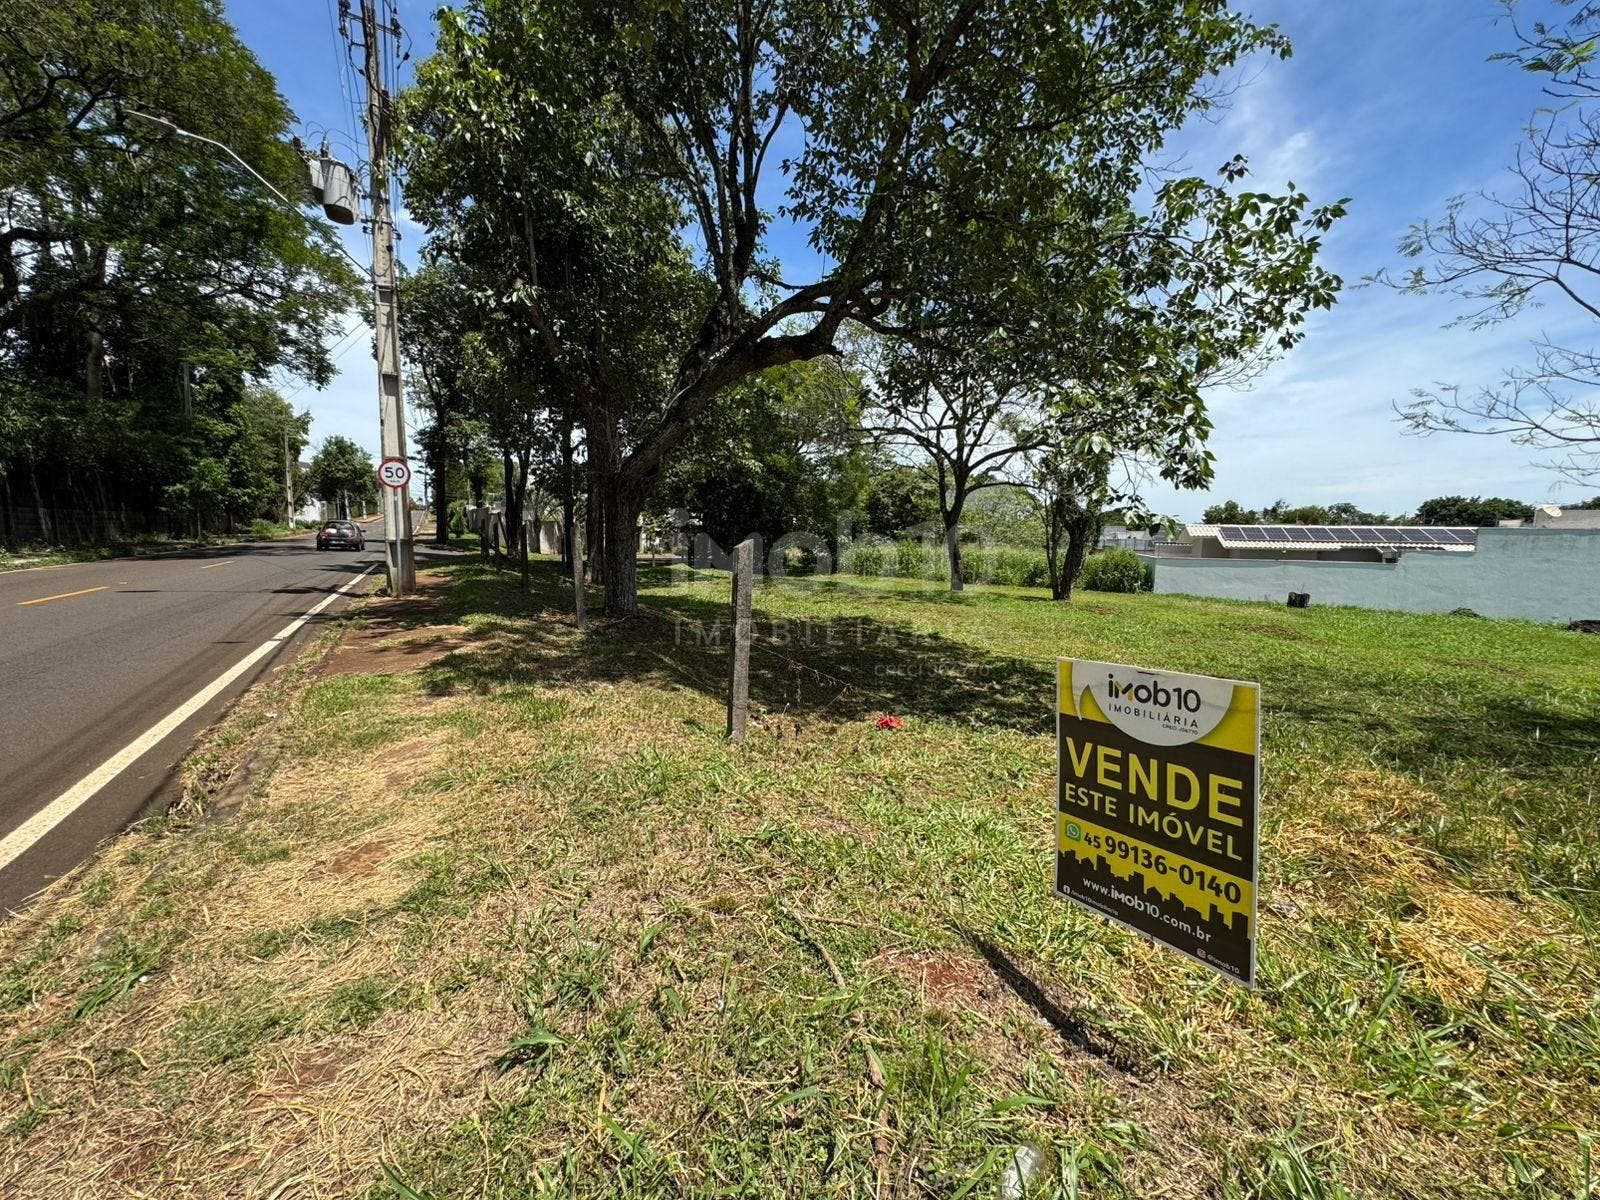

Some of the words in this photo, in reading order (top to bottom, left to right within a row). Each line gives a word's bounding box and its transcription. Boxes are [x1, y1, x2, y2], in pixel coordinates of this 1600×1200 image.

[384, 466, 405, 479] 50
[1108, 703, 1199, 729] IMOBILIÁRIA
[1066, 736, 1243, 828] VENDE
[1065, 782, 1118, 818] ESTE
[1129, 803, 1243, 861] IMÓVEL
[1083, 832, 1101, 849] 45
[1104, 835, 1242, 904] 99136-0140
